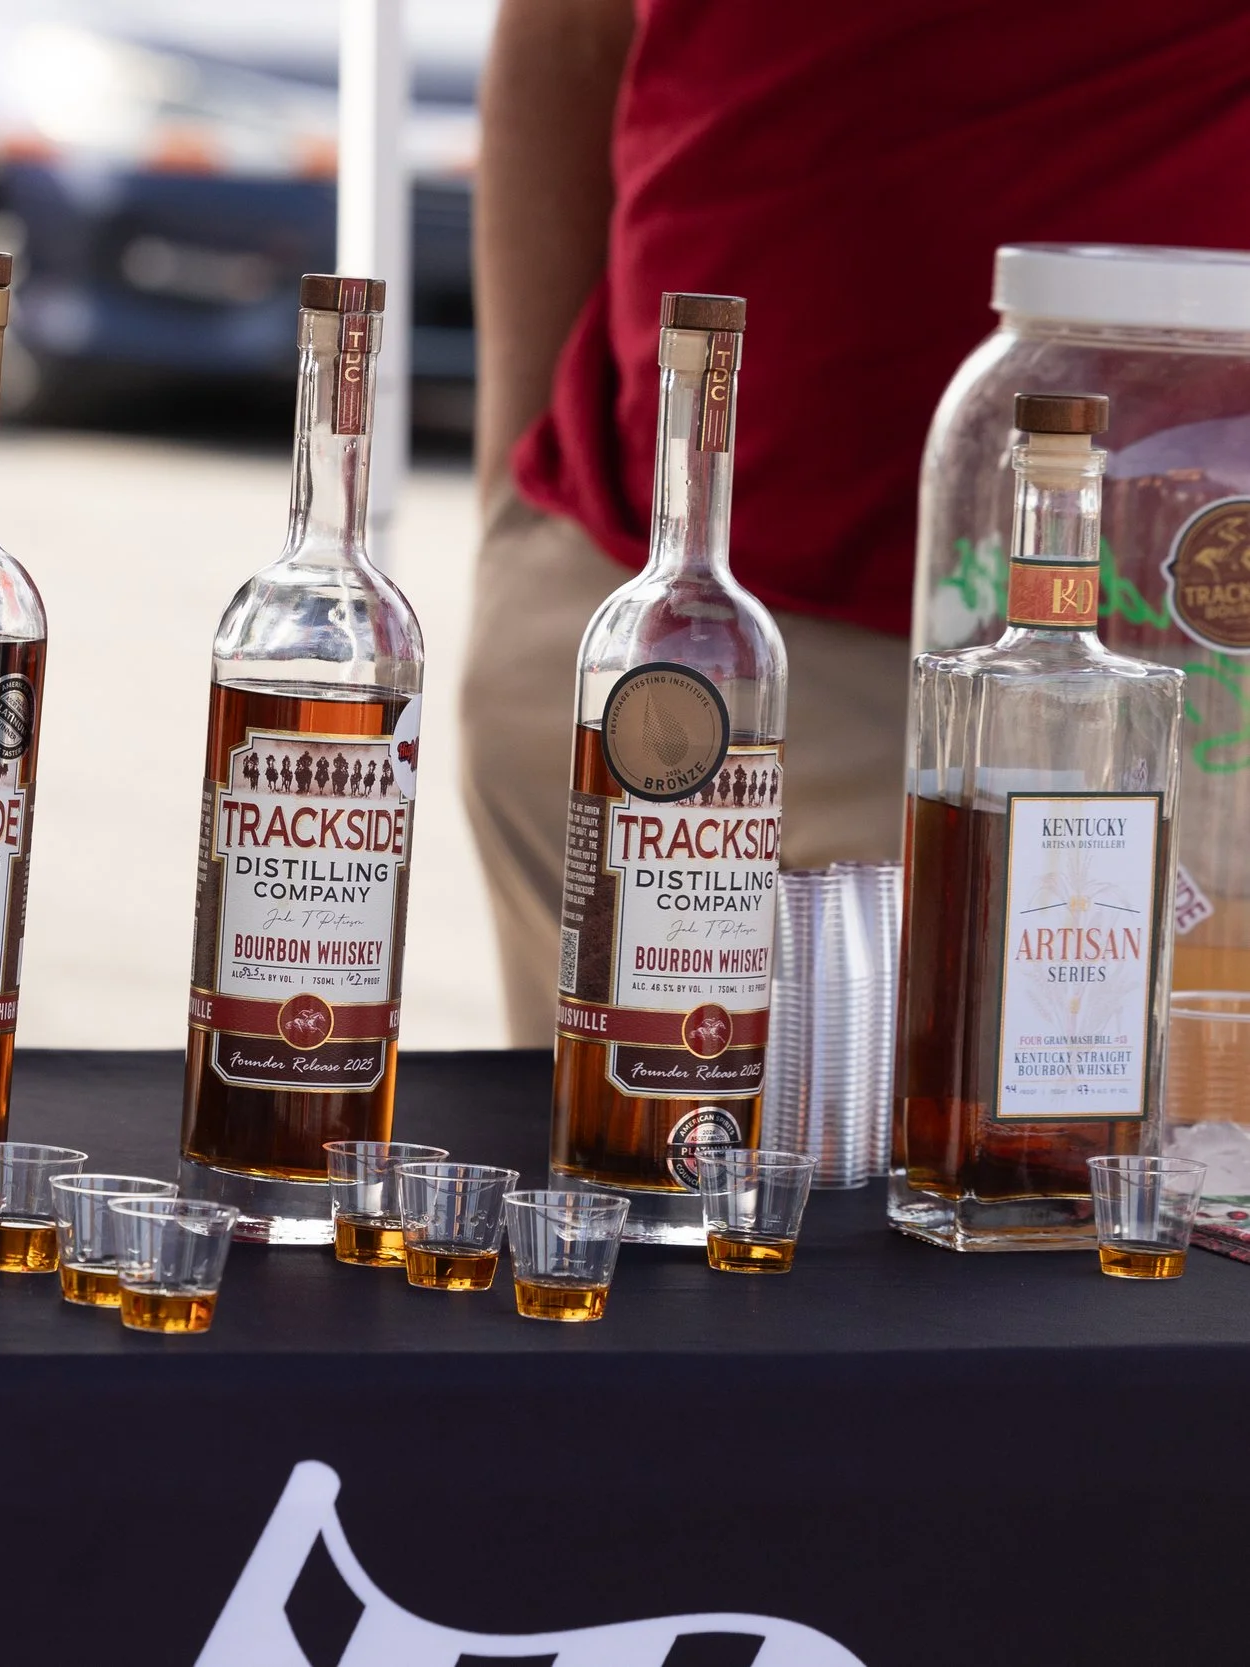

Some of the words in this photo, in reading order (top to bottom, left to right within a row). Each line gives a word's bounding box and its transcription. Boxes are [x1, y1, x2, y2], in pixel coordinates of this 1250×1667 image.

[711, 351, 731, 401] TDC
[610, 690, 631, 735] BEVERAGE
[630, 676, 667, 693] TESTING
[669, 677, 711, 708] INSTITUTE
[644, 761, 707, 791] BRONZE
[222, 800, 405, 853] TRACKSIDE
[1042, 818, 1127, 837] KENTUCKY
[1041, 840, 1076, 849] ARTISAN
[1078, 839, 1126, 849] DISTILLERY
[236, 856, 389, 882] DISTILLING
[636, 869, 773, 891] DISTILLING
[254, 881, 371, 903] COMPANY
[657, 893, 762, 912] COMPANY
[235, 933, 310, 964] BOURBON
[318, 940, 383, 965] WHISKEY
[1015, 928, 1141, 960] ARTISAN
[635, 946, 713, 973] BOURBON
[719, 947, 769, 973] WHISKEY
[280, 975, 294, 984] VOL.
[313, 977, 335, 985] 750ML
[364, 977, 381, 985] PROOF
[1048, 966, 1106, 983] SERIES
[632, 982, 648, 991] ALC.
[650, 983, 674, 992] 46.5%
[677, 984, 686, 992] BY
[689, 985, 703, 993] VOL.
[1019, 1036, 1042, 1045] FOUR
[1043, 1036, 1069, 1045] GRAIN
[1070, 1036, 1093, 1045] MASH
[1094, 1035, 1112, 1045] BILL
[230, 1051, 285, 1069] Founder
[293, 1056, 340, 1073] Release
[343, 1057, 374, 1071] 2025
[1014, 1052, 1073, 1063] KENTUCKY
[1076, 1051, 1132, 1063] STRAIGHT
[631, 1062, 690, 1078] Founder
[696, 1065, 738, 1081] Release
[1018, 1064, 1072, 1076] BOURBON
[1077, 1063, 1127, 1075] WHISKEY
[679, 1114, 715, 1137] AMERICAN
[715, 1115, 735, 1136] SPIRITS
